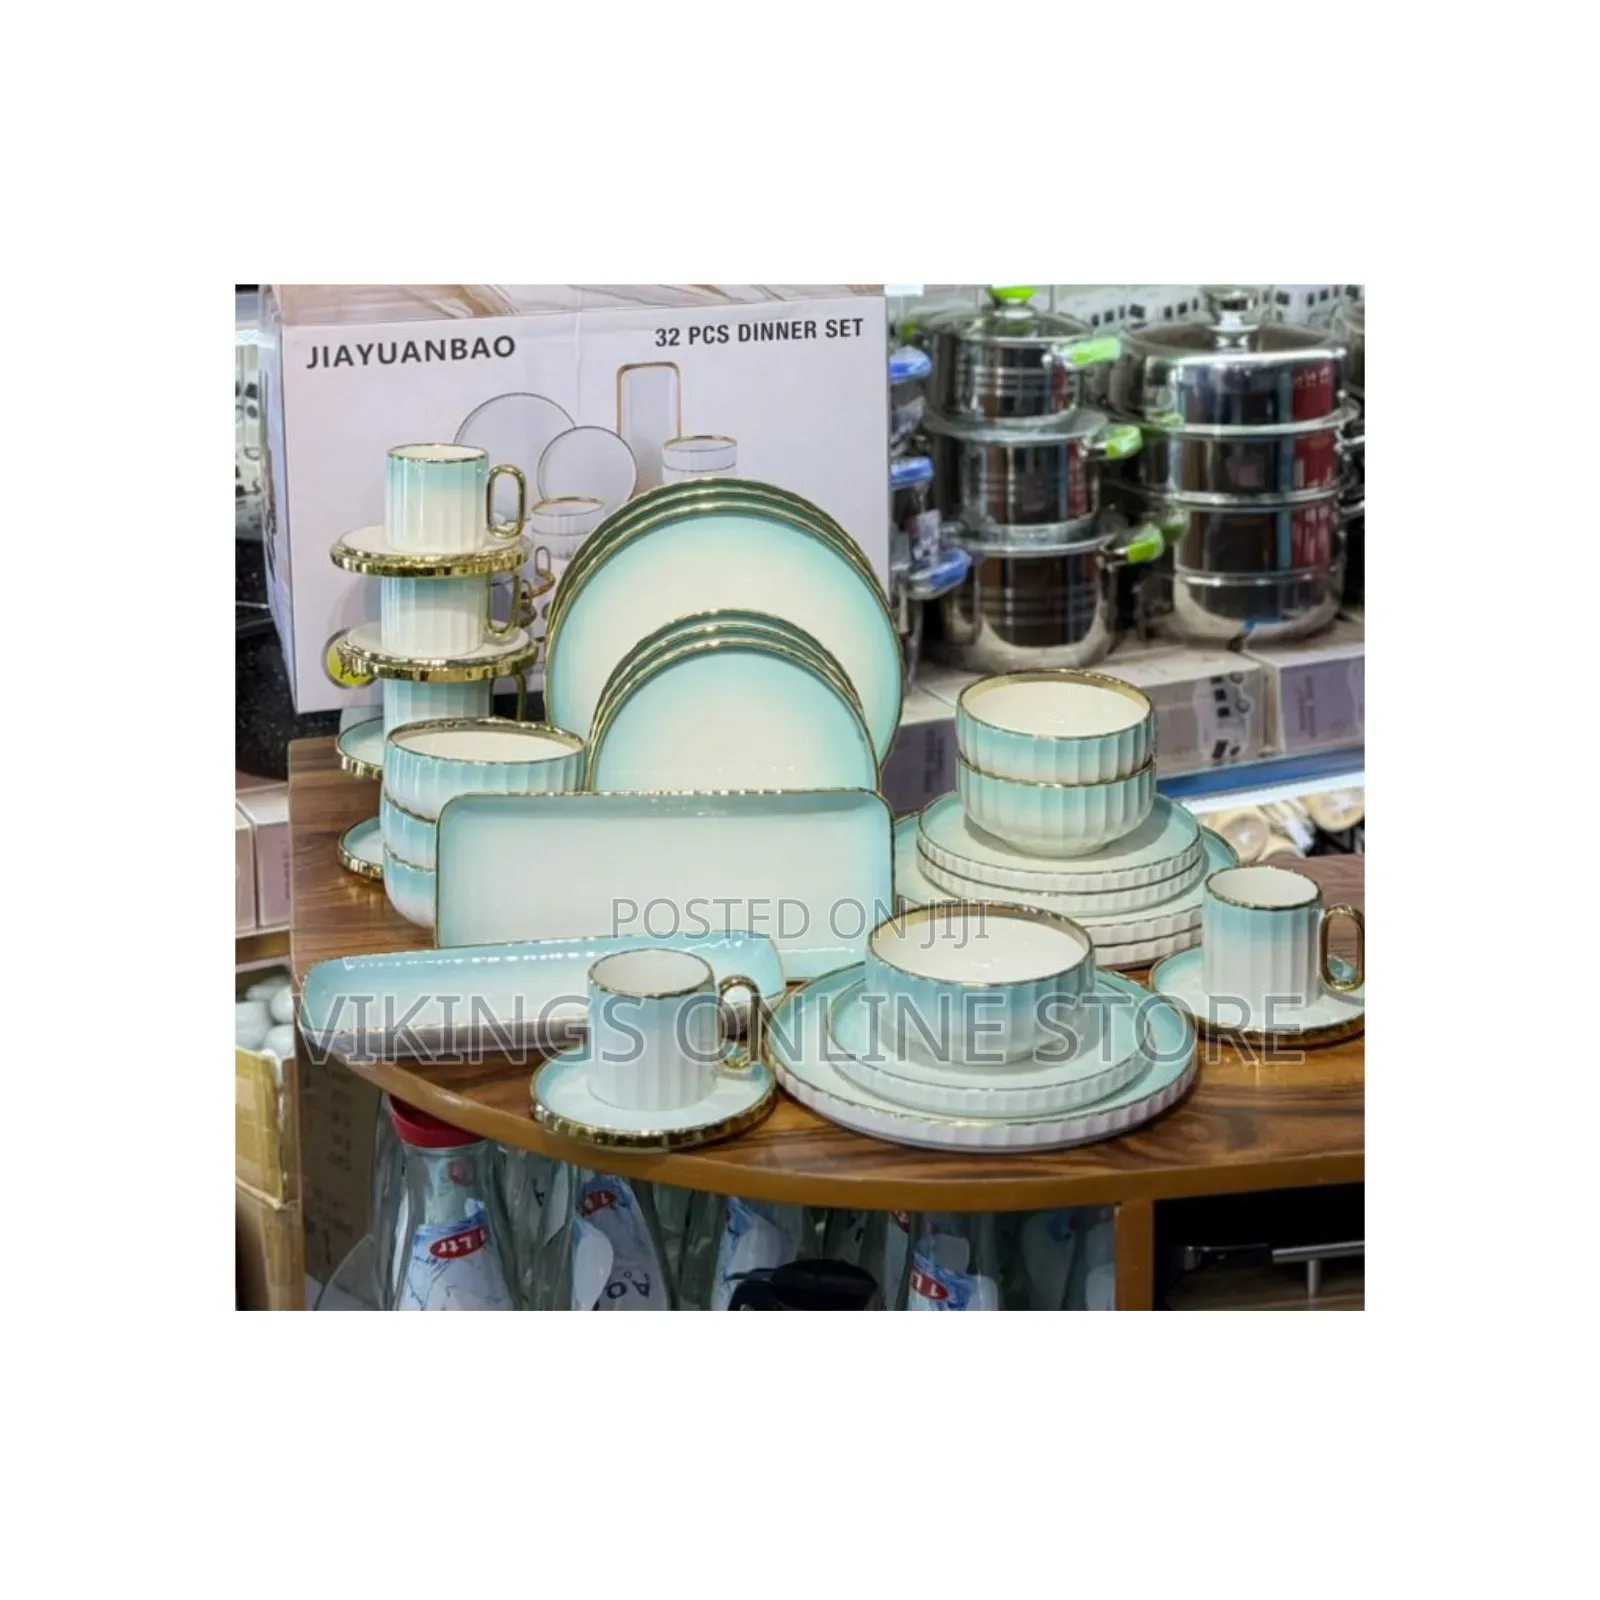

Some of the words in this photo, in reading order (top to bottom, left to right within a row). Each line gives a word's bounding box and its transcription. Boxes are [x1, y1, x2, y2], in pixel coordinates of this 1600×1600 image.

[655, 328, 680, 347] 32
[688, 325, 730, 345] PCS
[738, 320, 817, 342] DINNER
[825, 318, 864, 338] SET
[306, 335, 516, 368] JIAYUANBAO
